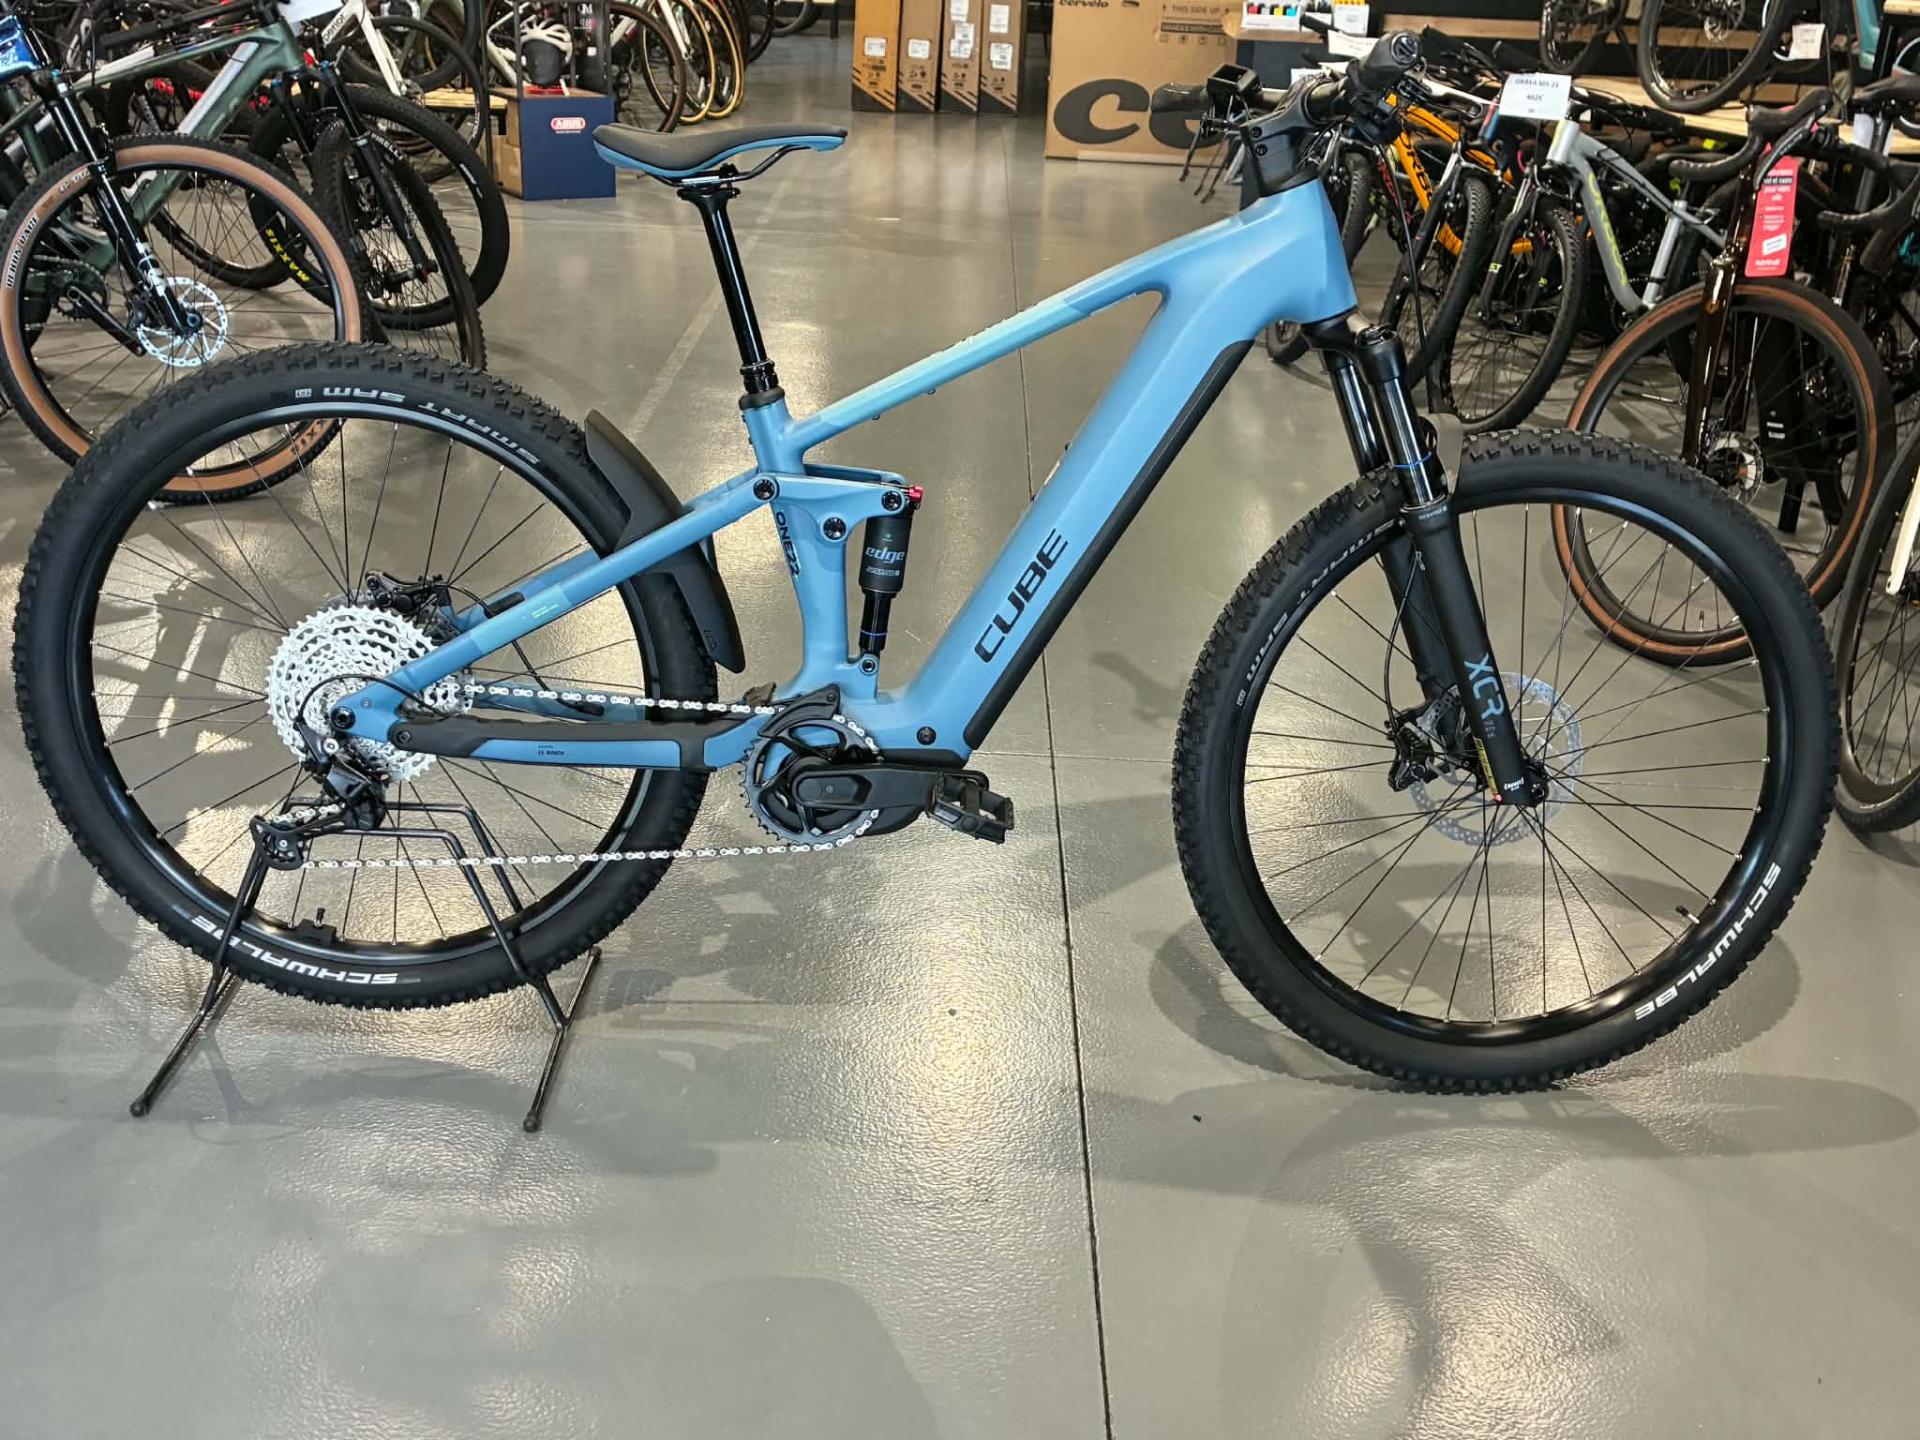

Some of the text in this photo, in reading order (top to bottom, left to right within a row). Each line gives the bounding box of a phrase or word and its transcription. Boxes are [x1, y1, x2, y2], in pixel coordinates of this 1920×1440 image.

[555, 119, 583, 130] ABUS
[265, 228, 311, 282] MAXXIS
[322, 387, 541, 466] SMART SAM
[865, 547, 906, 564] edge
[975, 528, 1068, 663] CUBE
[1246, 518, 1396, 681] SMART SAM
[1464, 652, 1505, 720] XCR
[1634, 862, 1782, 1021] SCHWALBE
